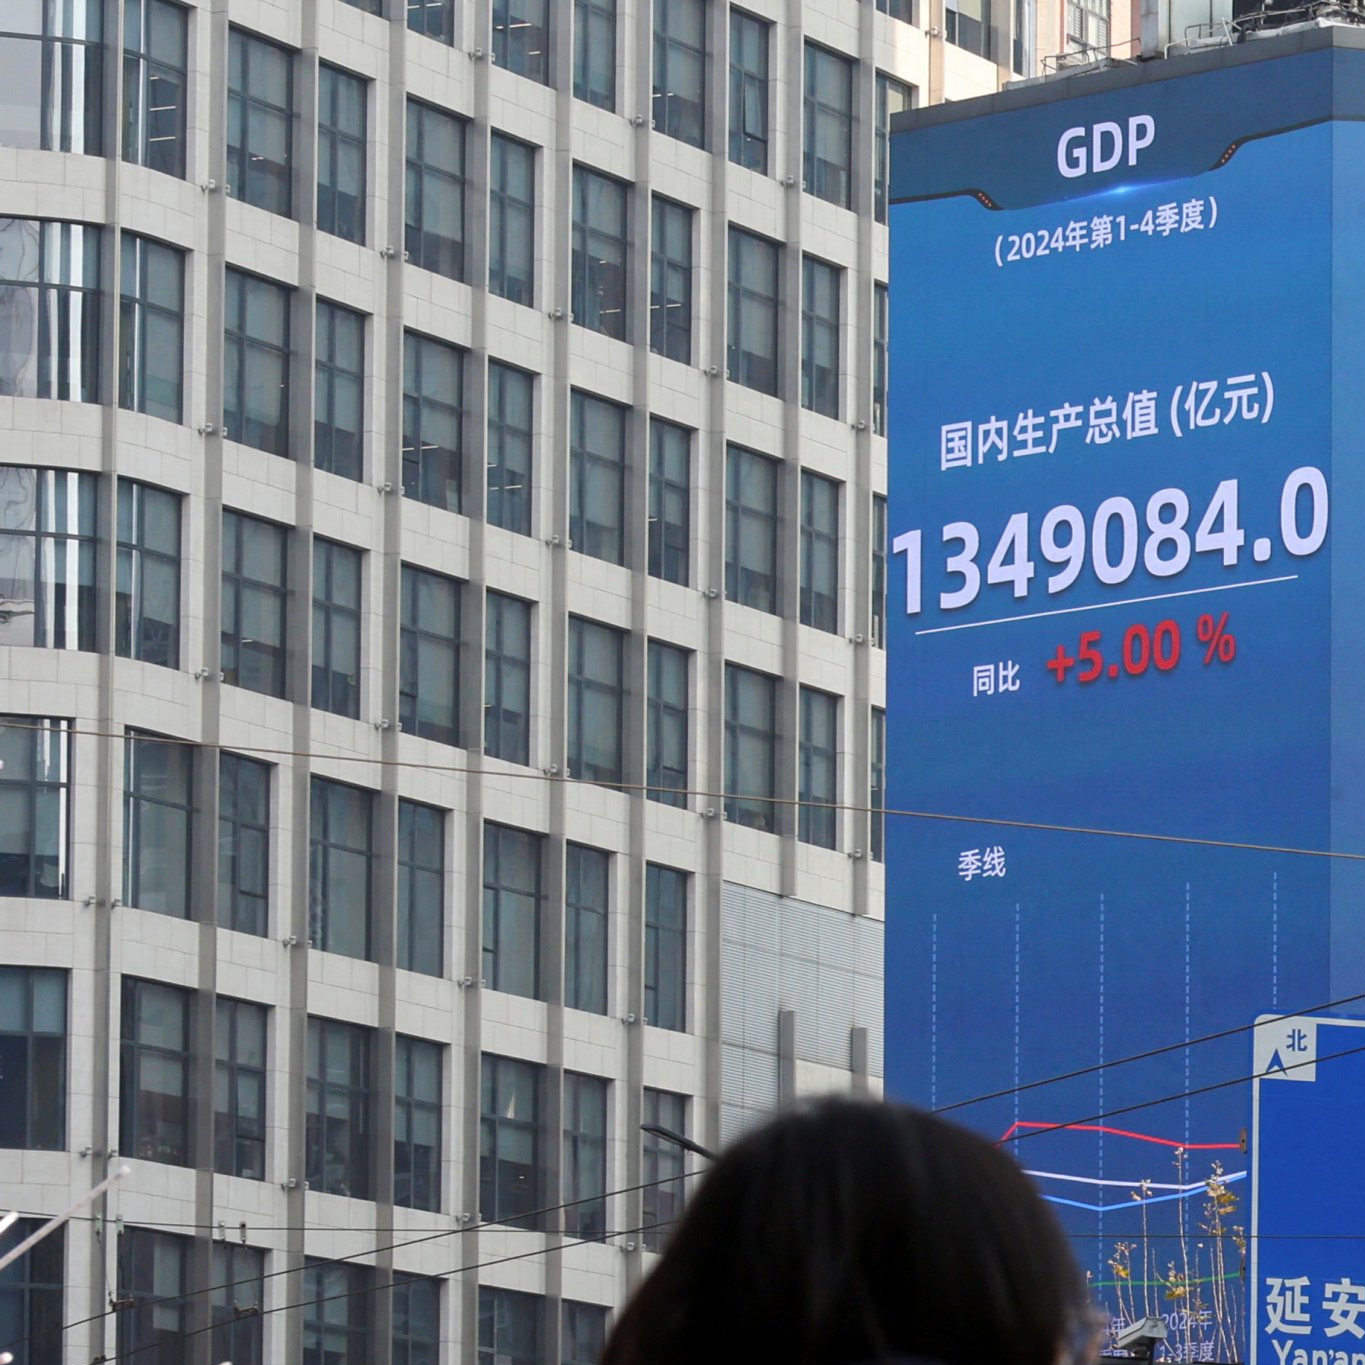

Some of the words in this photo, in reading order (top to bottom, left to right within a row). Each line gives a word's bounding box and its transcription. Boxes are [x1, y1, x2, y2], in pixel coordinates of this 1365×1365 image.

[1058, 115, 1155, 177] GDP
[995, 197, 1217, 266] (2024年第1-4季度)
[893, 466, 1329, 615] 1349084.0
[972, 660, 1020, 697] 同比
[1046, 620, 1181, 683] +5.00
[1197, 612, 1236, 663] %
[958, 846, 1006, 881] 季线
[1285, 1028, 1308, 1053] 北
